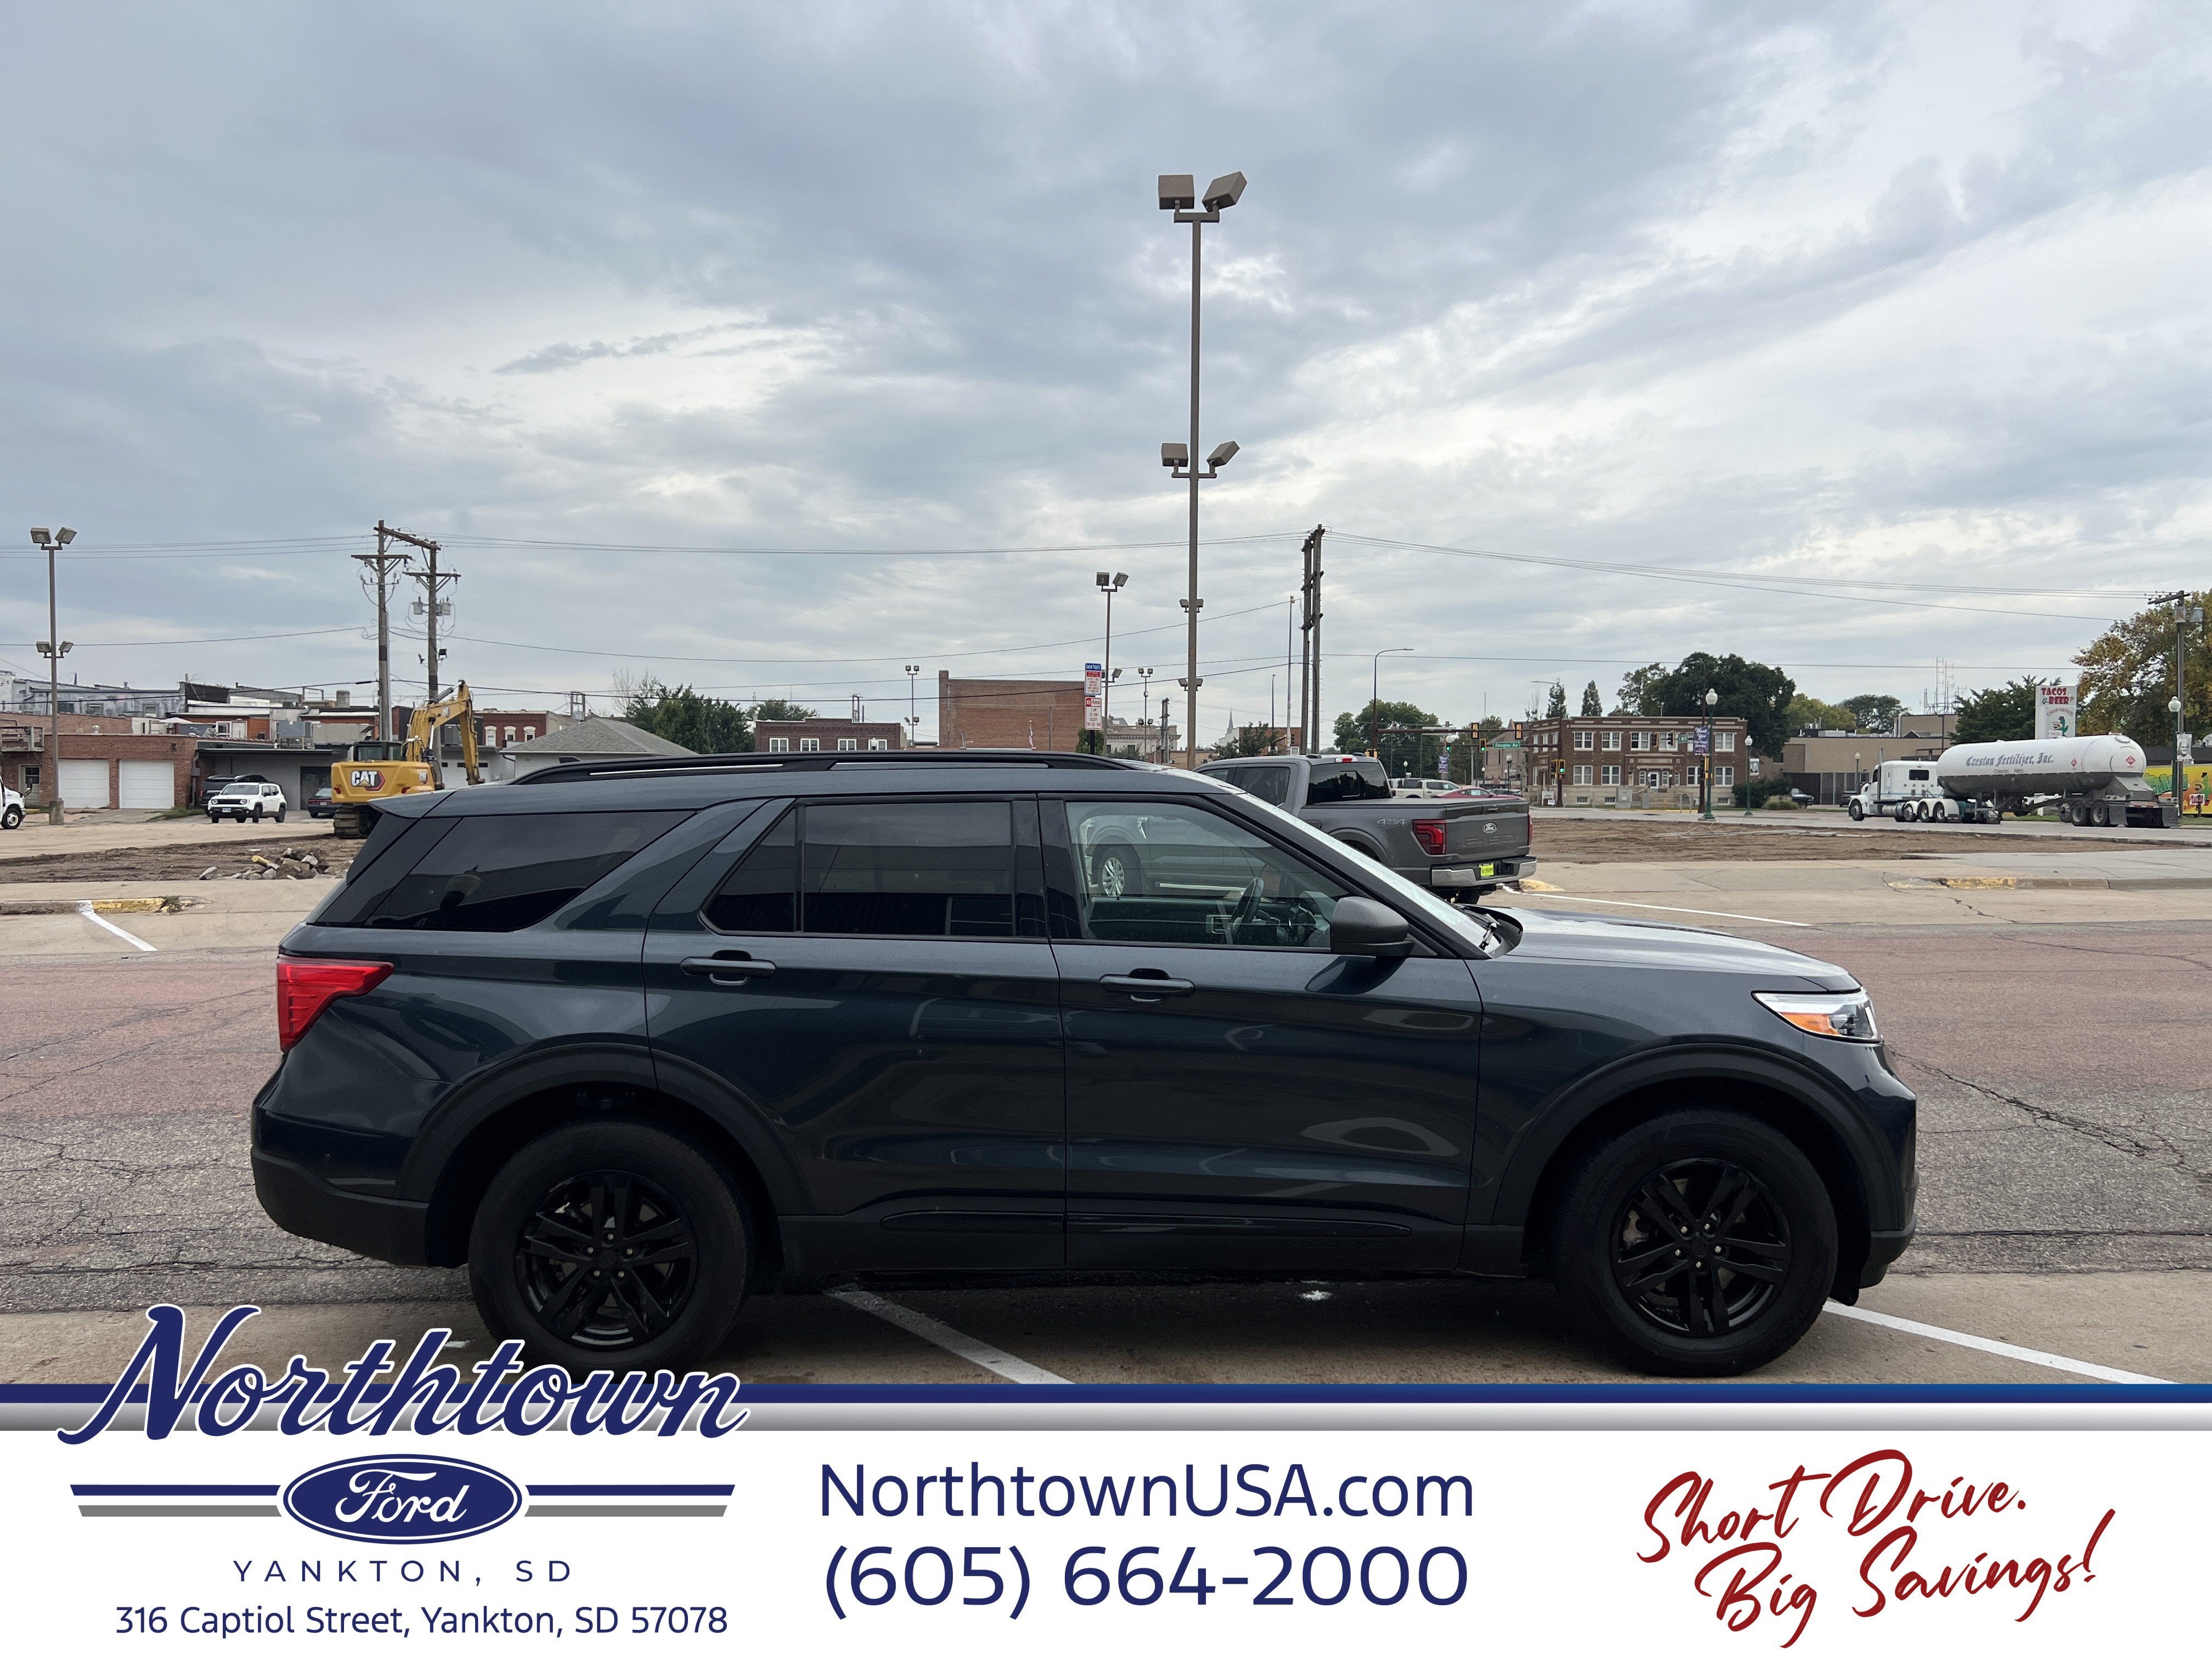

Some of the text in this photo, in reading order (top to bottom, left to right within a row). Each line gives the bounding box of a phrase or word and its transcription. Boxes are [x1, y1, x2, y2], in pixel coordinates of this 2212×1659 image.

[2041, 687, 2067, 696] TACOS
[2049, 696, 2069, 704] BEER
[1966, 752, 2053, 767] Creston Fertilizer, Inc.
[352, 770, 377, 787] CAT
[1463, 834, 1516, 847] F-150
